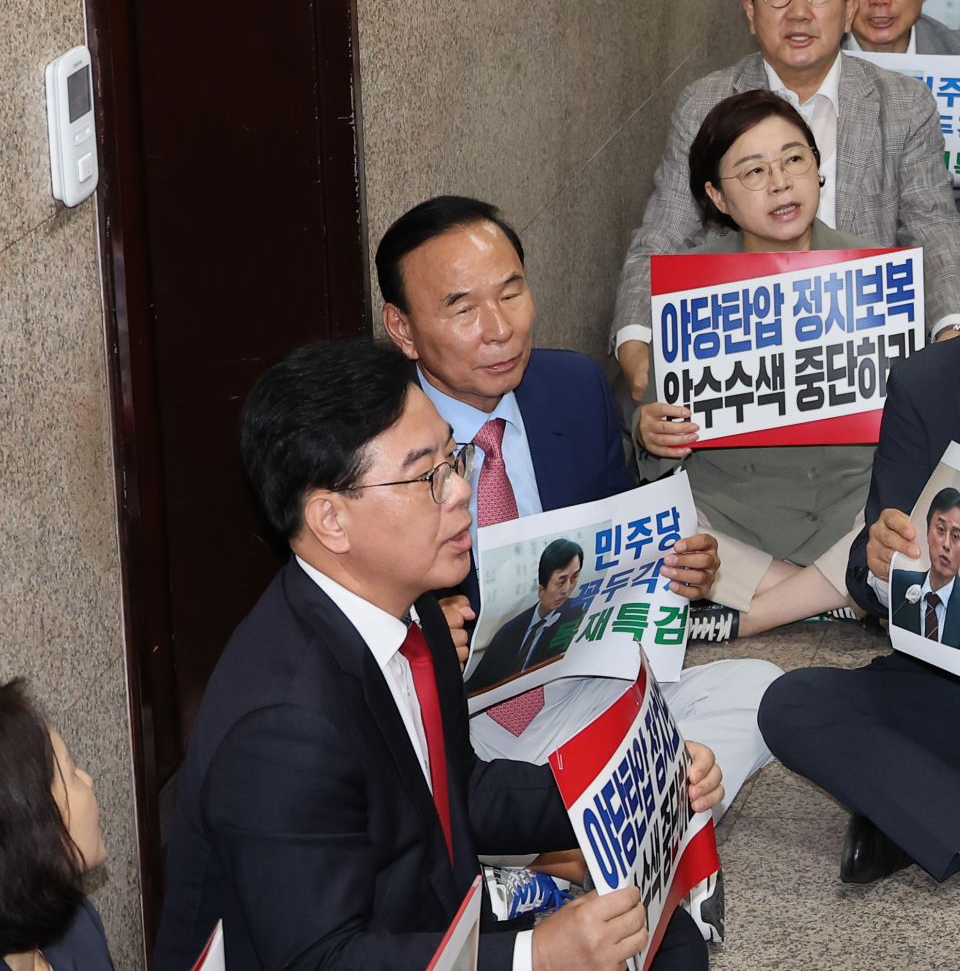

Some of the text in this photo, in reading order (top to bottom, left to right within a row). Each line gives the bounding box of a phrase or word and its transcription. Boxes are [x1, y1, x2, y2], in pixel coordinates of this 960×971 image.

[661, 258, 915, 364] 야당탄압 정치보복
[594, 507, 682, 571] 민주당
[570, 557, 680, 613] 꼭두각
[583, 727, 656, 890] 야당탄압
